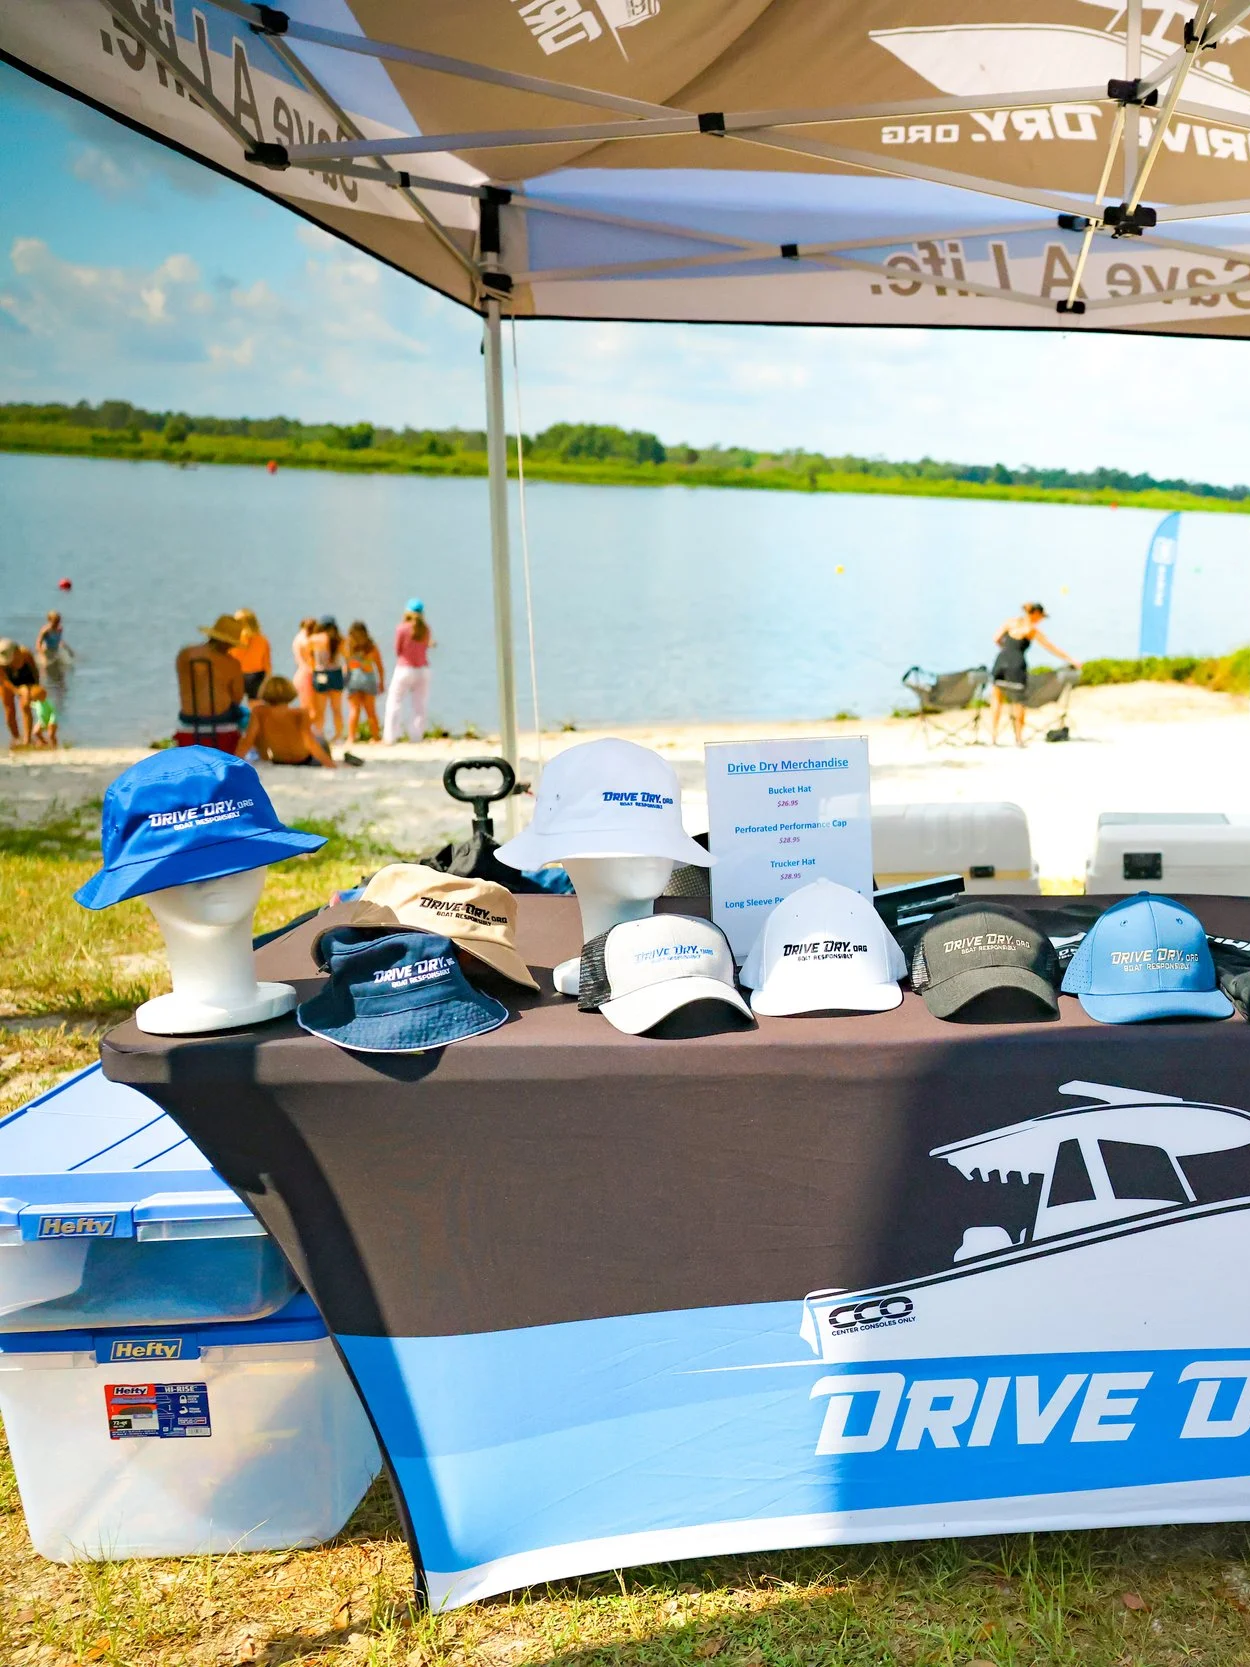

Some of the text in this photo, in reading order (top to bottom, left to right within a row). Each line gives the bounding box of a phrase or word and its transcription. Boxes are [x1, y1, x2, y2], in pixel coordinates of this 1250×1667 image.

[727, 757, 849, 773] Drive Dry Merchandise
[603, 792, 638, 801] DRIVE
[768, 785, 812, 795] Bucket Hat
[777, 800, 799, 808] $26.95
[148, 807, 198, 827] DRIVE
[735, 819, 847, 834] Perforated Performance Cap
[779, 836, 800, 844] $28.95
[770, 858, 816, 868] Trucker Hat
[780, 873, 801, 881] $28.95
[420, 897, 462, 911] DRIVE
[725, 900, 745, 909] Long
[746, 897, 773, 907] Sleeve
[783, 942, 820, 956] DRIVE
[943, 936, 984, 953] DRIVE
[961, 946, 977, 954] BOAT
[1111, 949, 1153, 965] DRIVE
[373, 965, 413, 984] DRIVE
[1124, 964, 1142, 972] BOAT
[43, 1217, 112, 1236] Hefty
[829, 1296, 914, 1328] CCO
[832, 1316, 916, 1336] CENTER CONSOLES ONLY
[116, 1342, 177, 1359] Hefty
[115, 1386, 147, 1395] Hefty
[809, 1371, 1153, 1456] DRIVE
